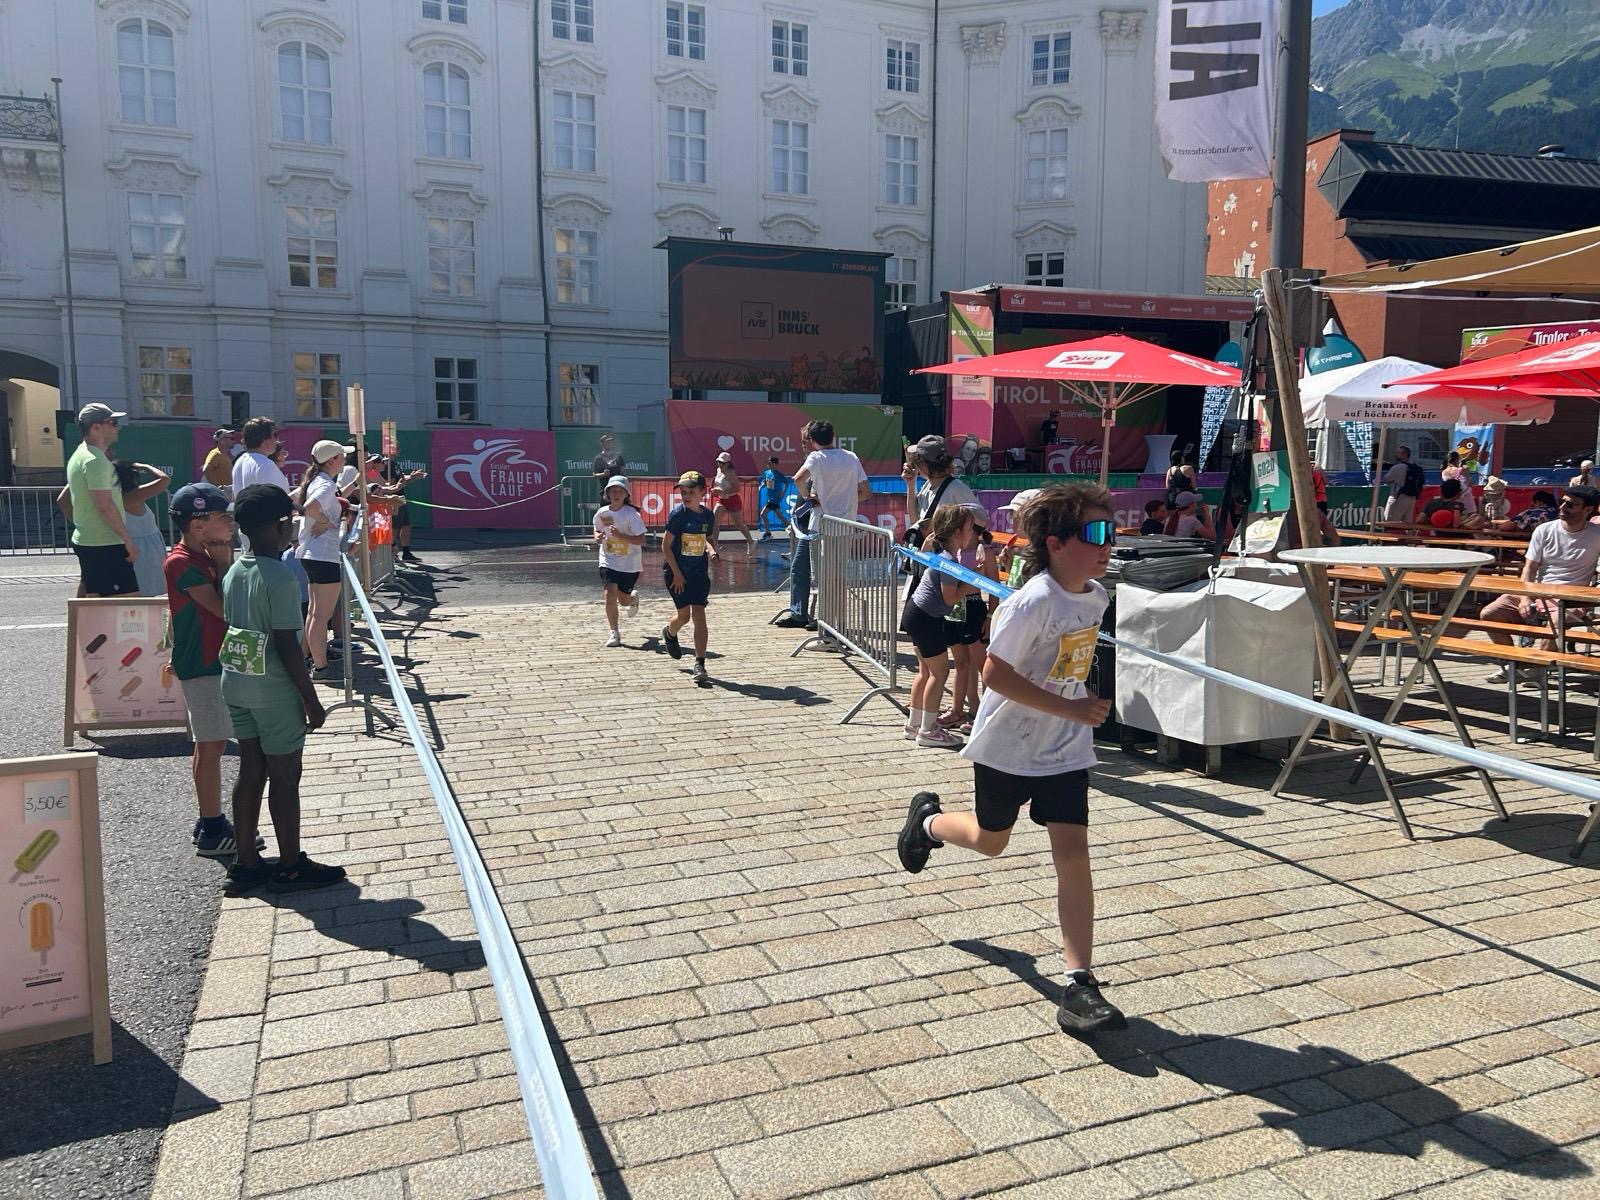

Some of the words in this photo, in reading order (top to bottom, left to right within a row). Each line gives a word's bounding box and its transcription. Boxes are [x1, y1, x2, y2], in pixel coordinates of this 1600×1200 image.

[747, 317, 767, 328] IVB
[778, 323, 820, 336] BRUCK
[1533, 330, 1570, 346] Tiroler
[994, 385, 1051, 404] TIROL
[1365, 401, 1418, 409] Braukunst
[1344, 410, 1361, 418] auf
[1364, 410, 1407, 419] höchster
[1410, 411, 1439, 419] Stufe.
[742, 435, 796, 452] TIROL
[565, 459, 593, 470] Tiroler
[1257, 457, 1275, 478] 6020
[490, 469, 542, 485] FRAUEN
[490, 484, 524, 497] LAUF
[228, 641, 249, 656] 646
[1072, 645, 1093, 662] 837
[25, 795, 69, 812] 3,50€
